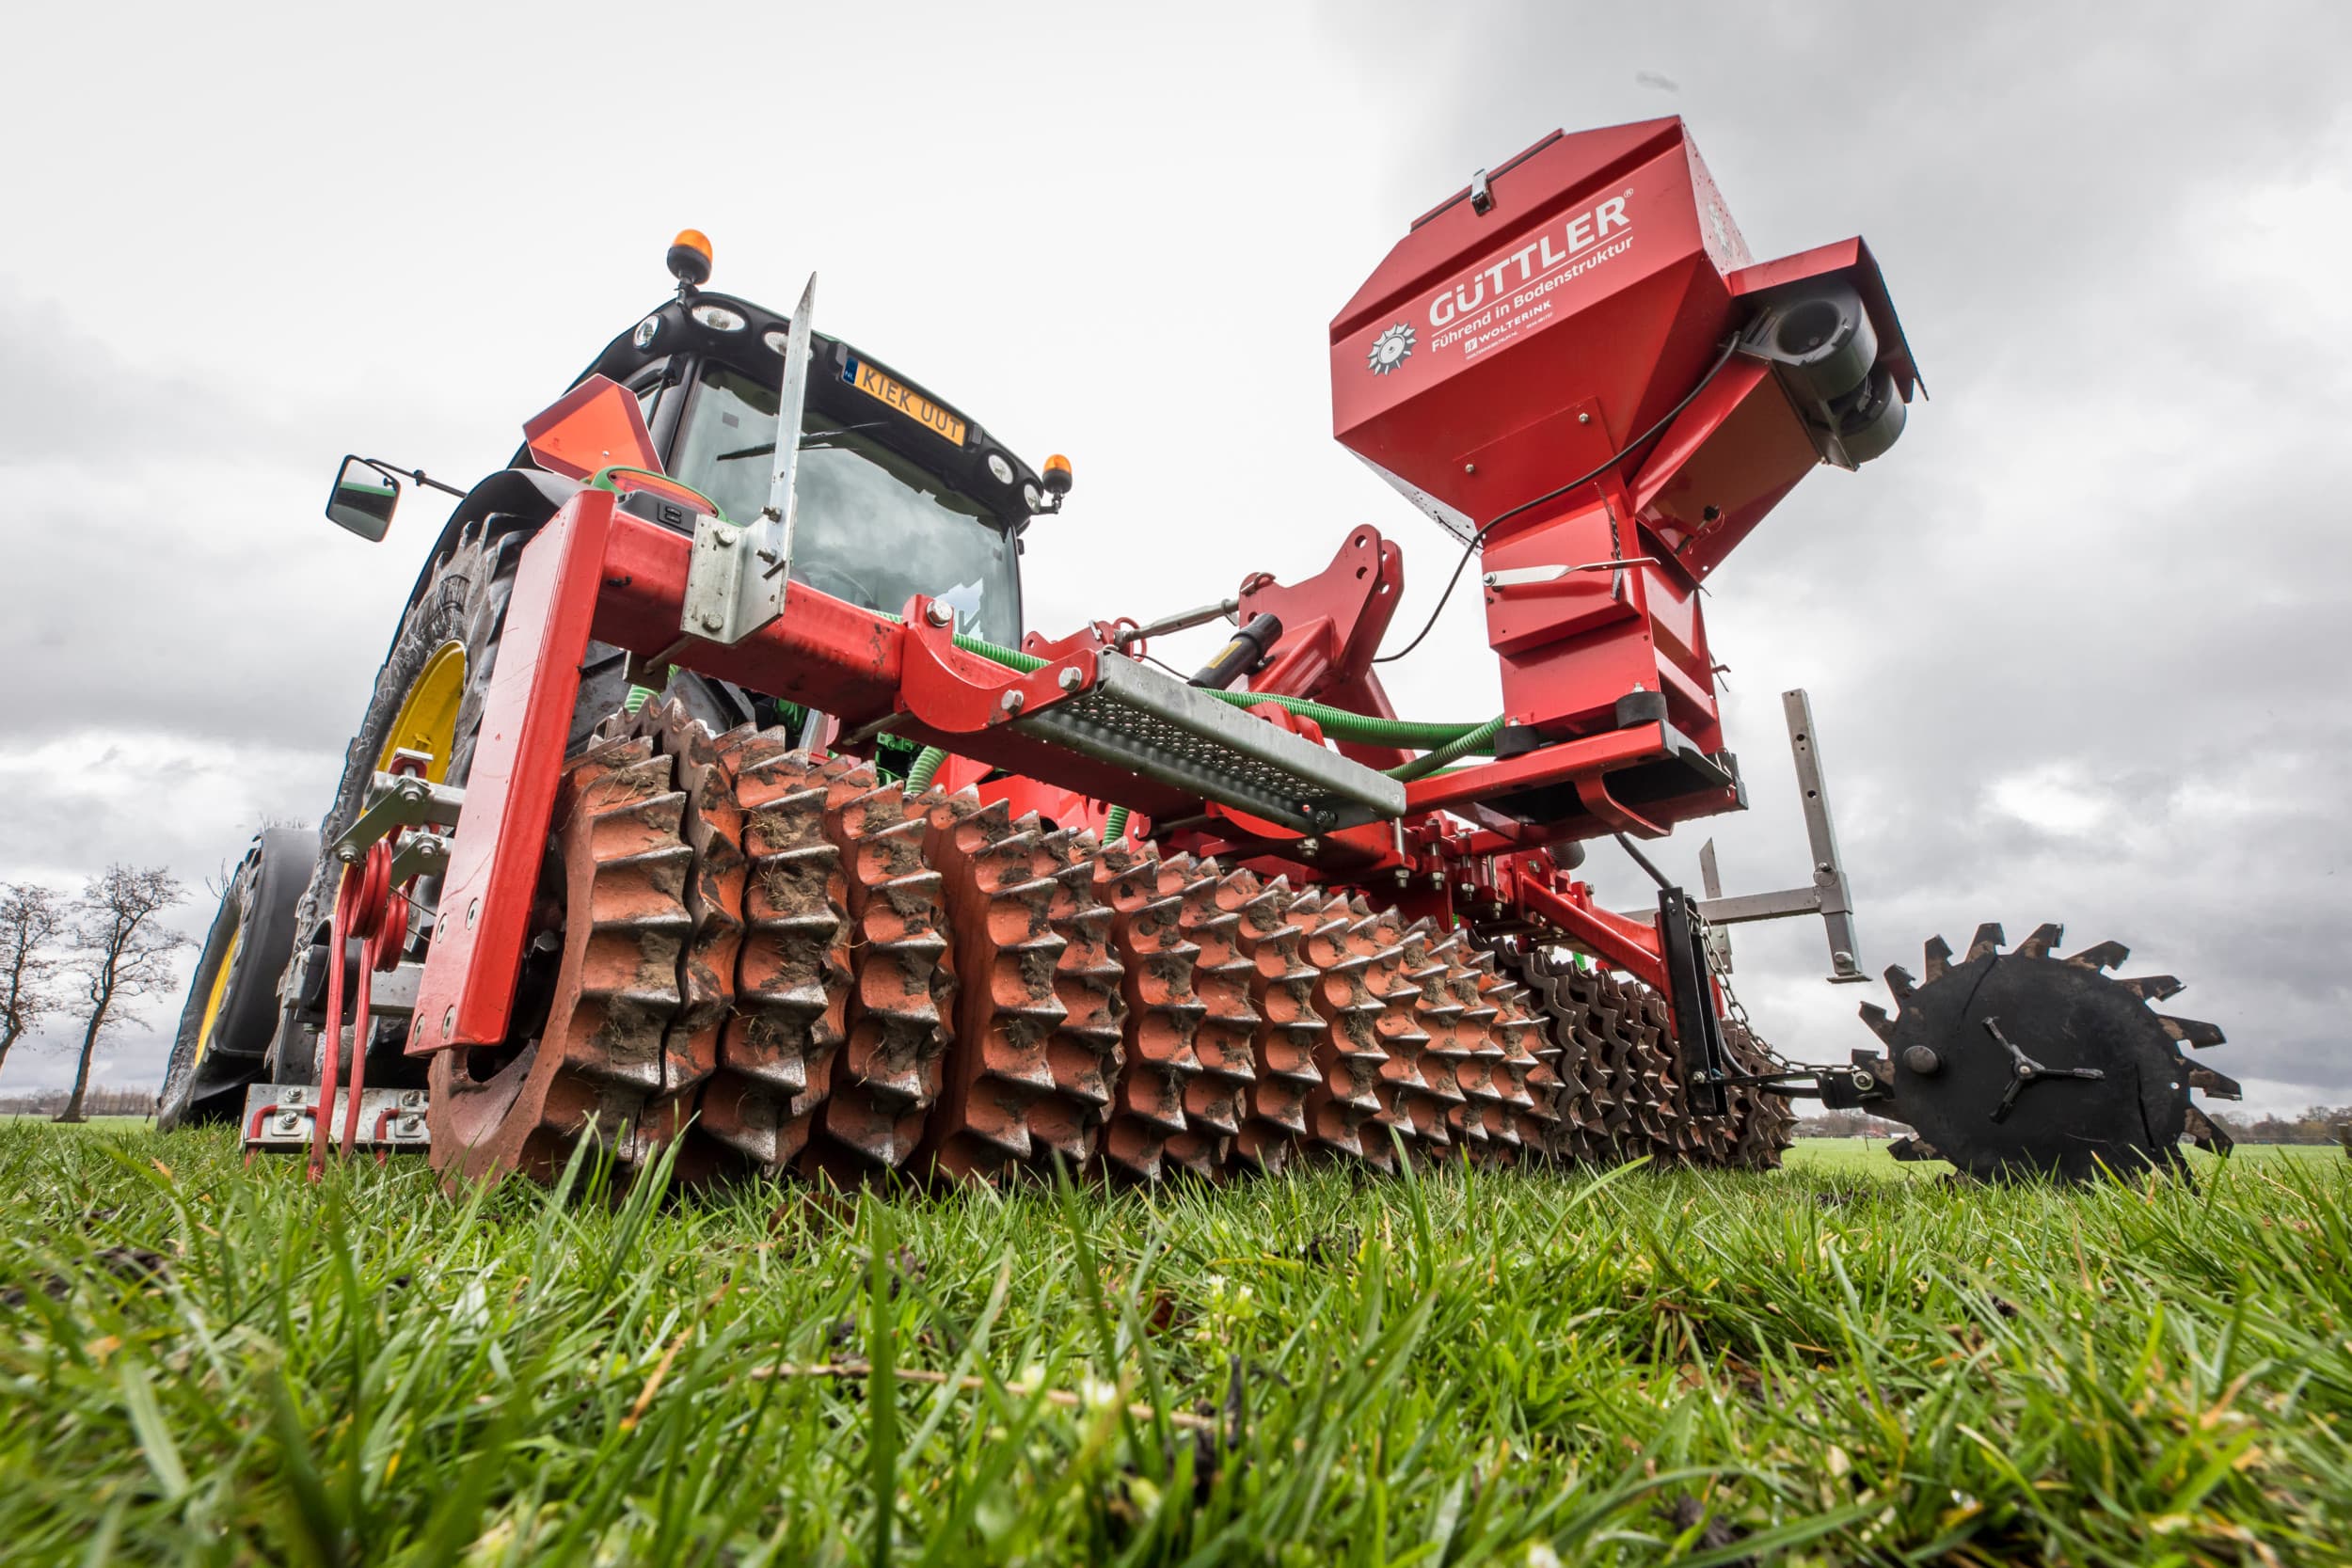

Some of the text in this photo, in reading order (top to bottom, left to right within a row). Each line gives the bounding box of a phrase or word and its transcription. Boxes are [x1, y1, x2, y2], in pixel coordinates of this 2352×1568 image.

[1432, 311, 1491, 353] Führend
[1495, 304, 1510, 319] in
[1513, 236, 1634, 309] Bodenstruktur
[1479, 300, 1551, 343] WOLTERINK
[863, 368, 960, 437] KIEK UUT
